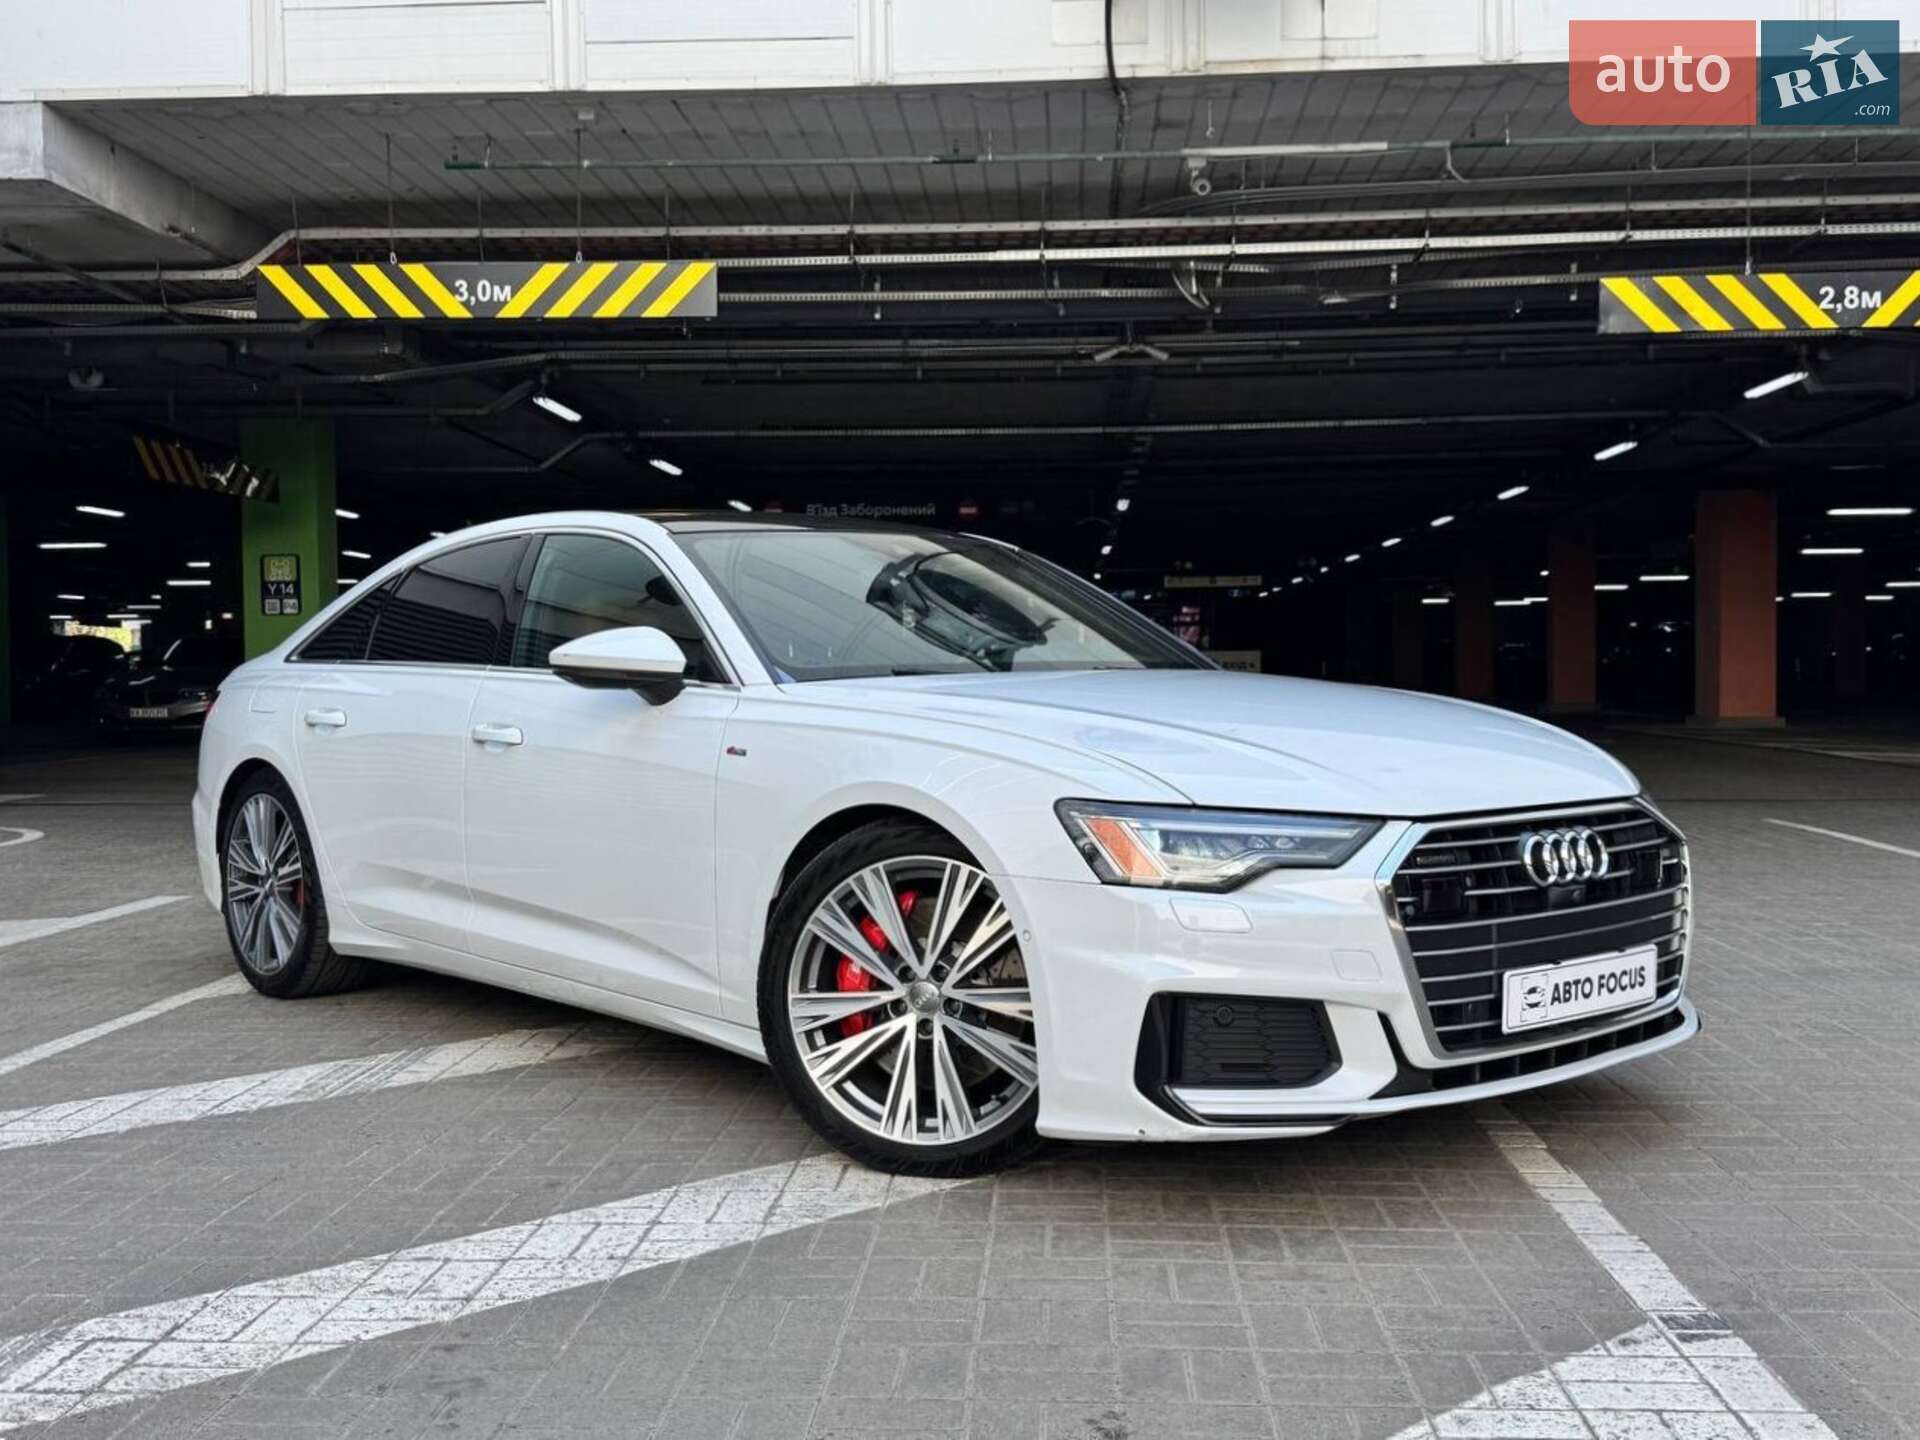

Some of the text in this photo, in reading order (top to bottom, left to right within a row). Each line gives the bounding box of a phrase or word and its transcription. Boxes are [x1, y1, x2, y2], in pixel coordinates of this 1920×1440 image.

[454, 279, 512, 306] 3,0м
[1819, 285, 1882, 313] 2,8м
[1597, 965, 1646, 996] FOCUS
